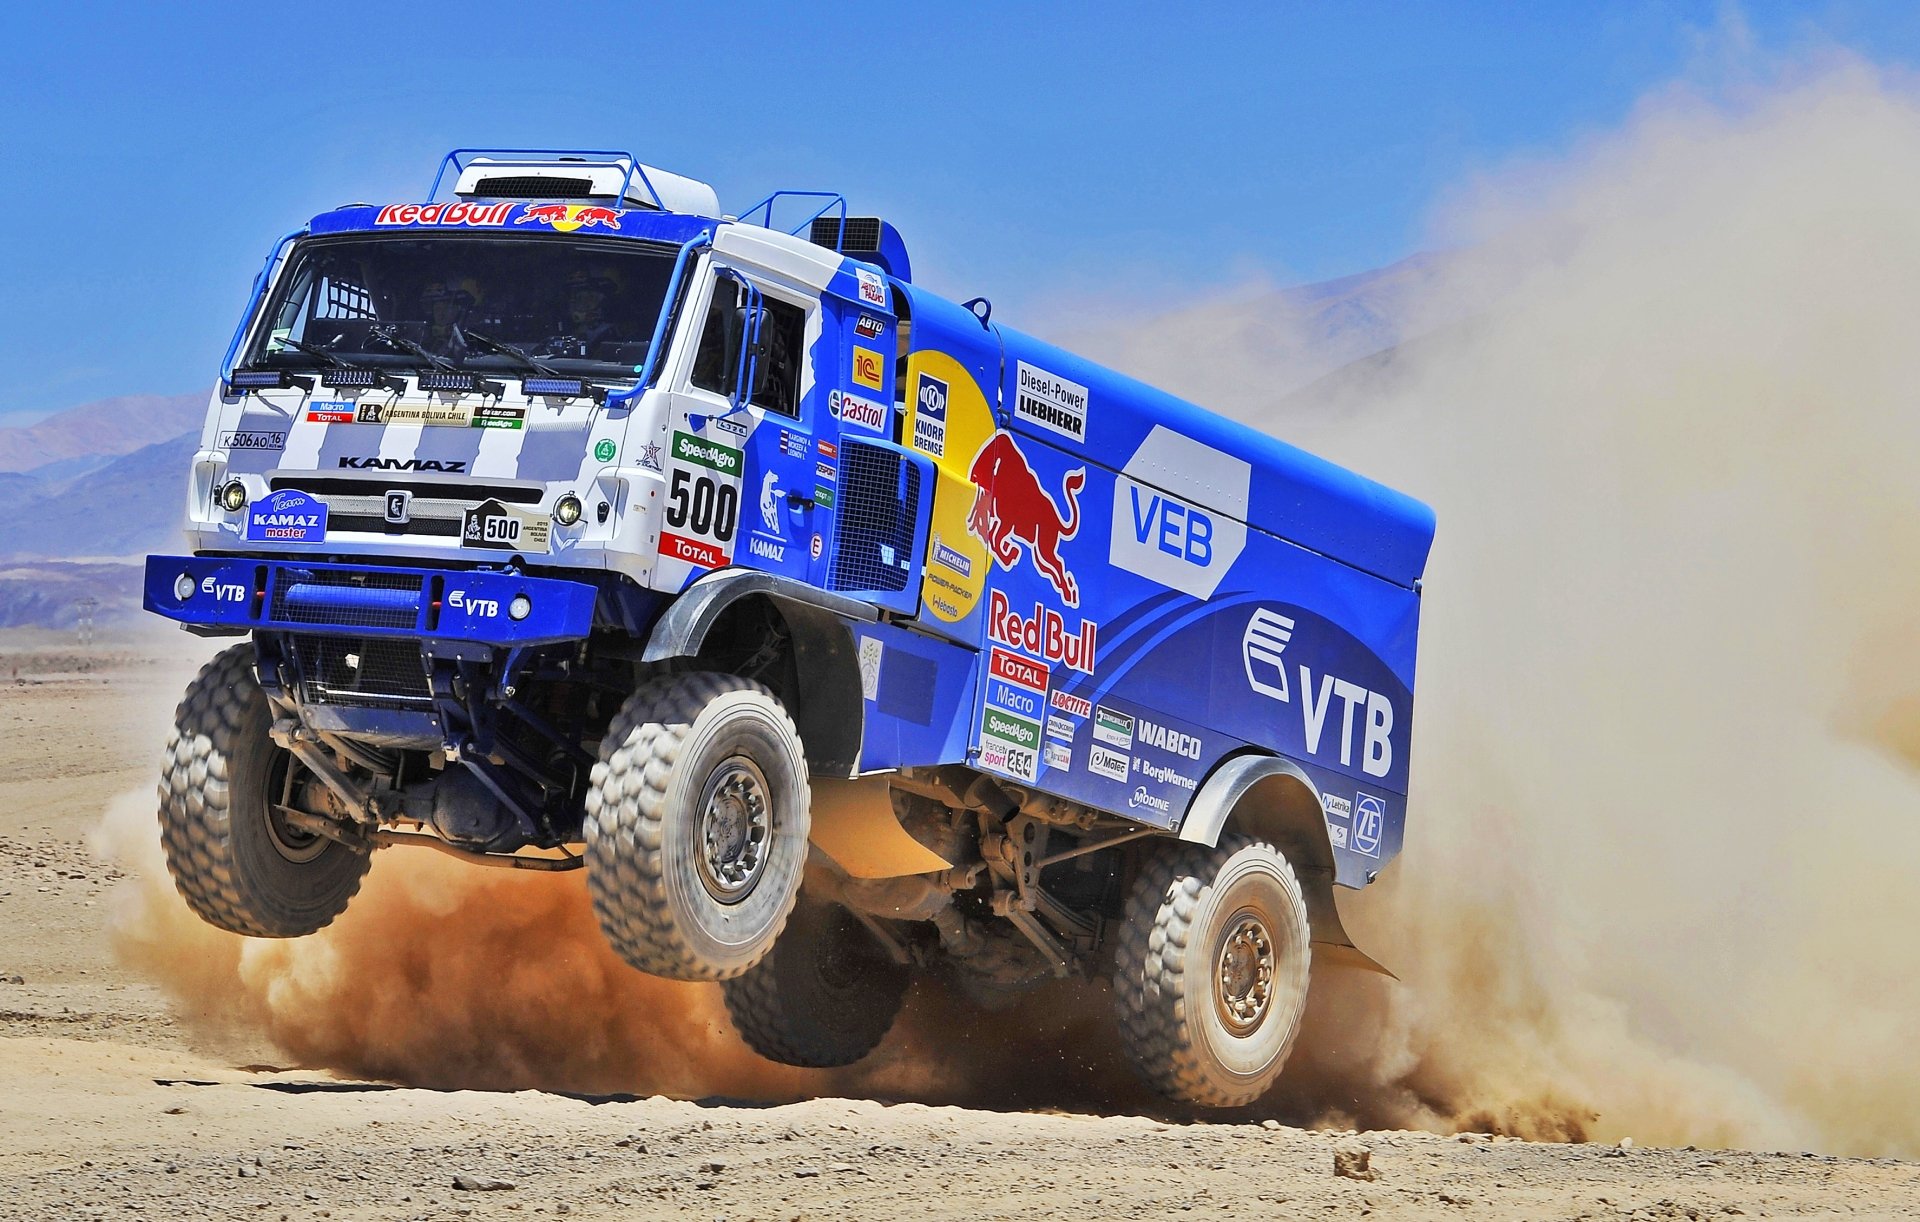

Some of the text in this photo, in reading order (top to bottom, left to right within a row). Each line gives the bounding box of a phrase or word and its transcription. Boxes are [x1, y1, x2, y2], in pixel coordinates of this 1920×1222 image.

[376, 203, 514, 225] Red Bull
[1021, 369, 1085, 410] Diesel-Power
[320, 402, 345, 411] Macro
[447, 412, 466, 421] CHILE
[842, 397, 884, 429] Castrol
[1019, 394, 1082, 436] LIEBHERR
[270, 432, 281, 444] 16
[915, 418, 944, 442] KNORR
[679, 438, 735, 468] SpeedAgro
[914, 435, 943, 457] BREMSE
[338, 457, 466, 474] KAMAZ
[271, 493, 305, 512] Team
[666, 468, 738, 542] 500
[253, 513, 319, 527] KAMAZ
[487, 518, 519, 540] 500
[1130, 485, 1213, 568] VEB
[265, 527, 307, 539] master
[750, 537, 785, 562] KAMAZ
[813, 539, 820, 554] E
[940, 549, 970, 572] MICHELIN
[216, 585, 246, 602] VTB
[465, 600, 499, 618] VTB
[989, 590, 1096, 673] Red Bull
[996, 685, 1034, 714] Macro
[1052, 692, 1091, 716] LOCTITE
[989, 715, 1034, 742] SpeedAgro
[1300, 664, 1394, 778] VTB
[1138, 719, 1202, 761] WABCO
[985, 750, 1006, 768] sport
[1142, 760, 1198, 791] BorgWarner
[1133, 791, 1170, 812] MODINE
[1357, 807, 1381, 844] ZF
